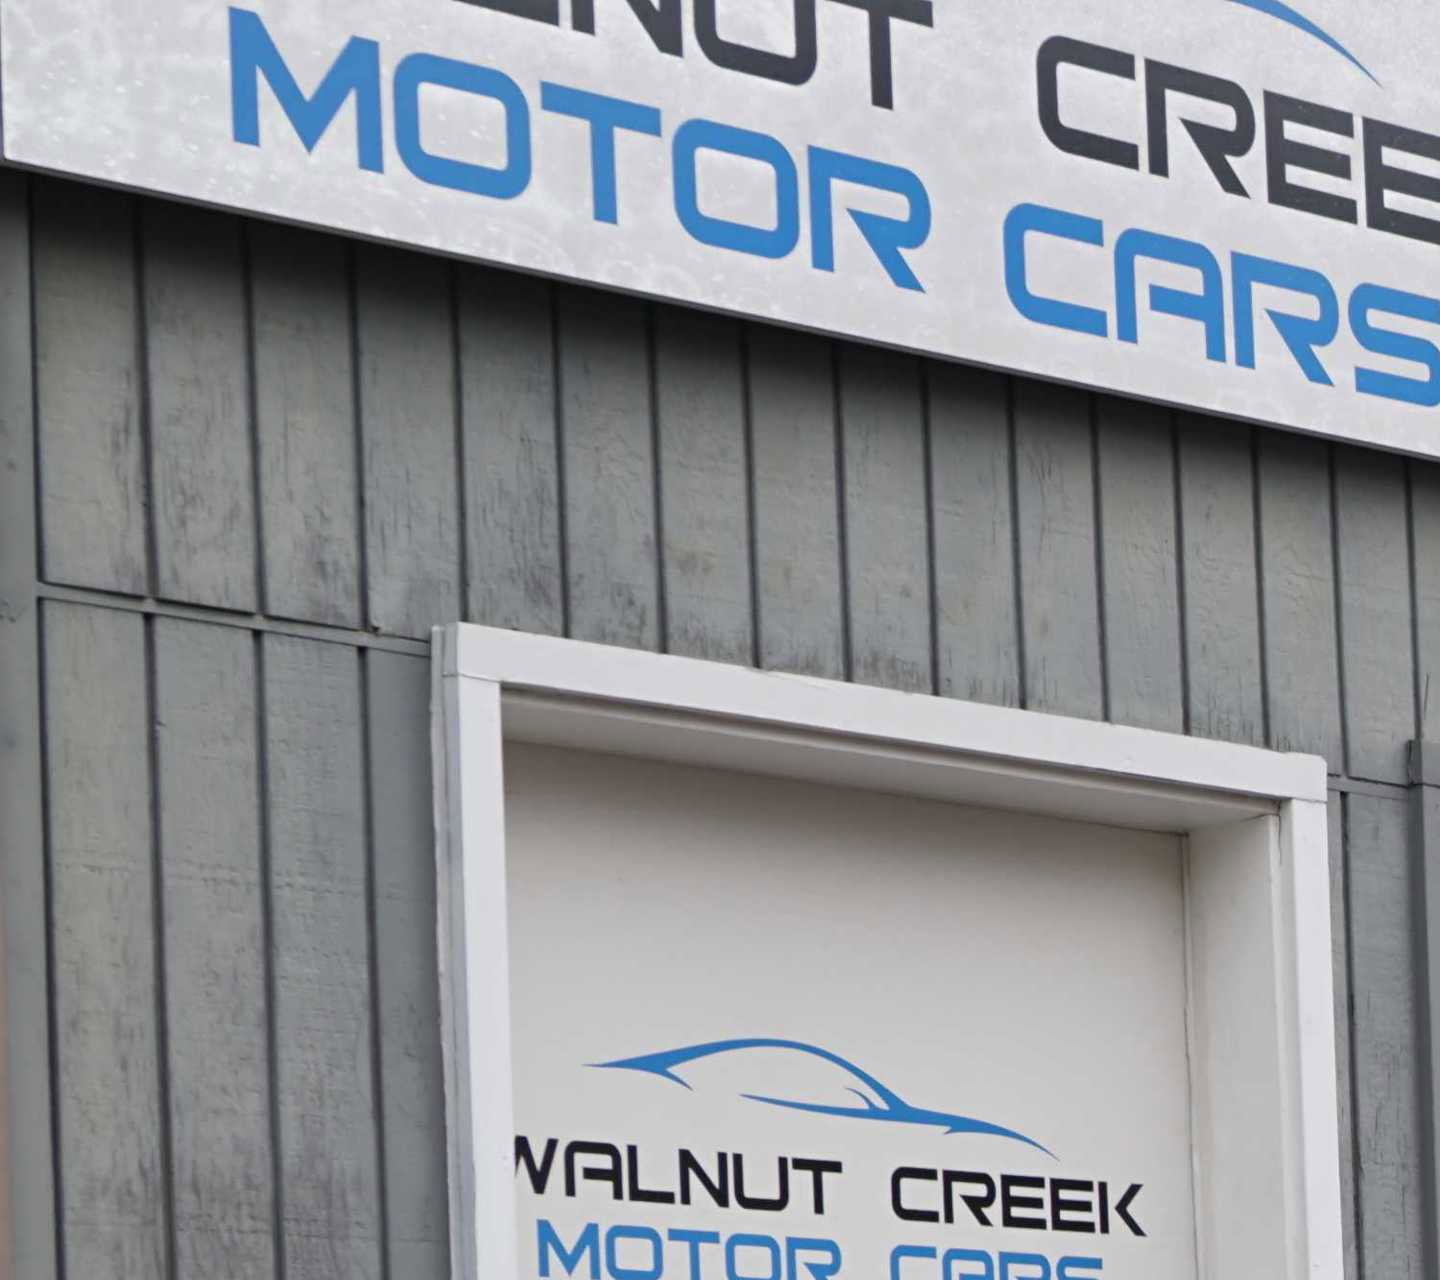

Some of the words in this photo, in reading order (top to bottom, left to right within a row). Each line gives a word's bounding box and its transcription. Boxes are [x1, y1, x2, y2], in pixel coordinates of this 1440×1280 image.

[231, 6, 932, 293] MOTOR
[514, 1135, 842, 1214] WALNUT
[891, 1166, 1147, 1237] CREEK
